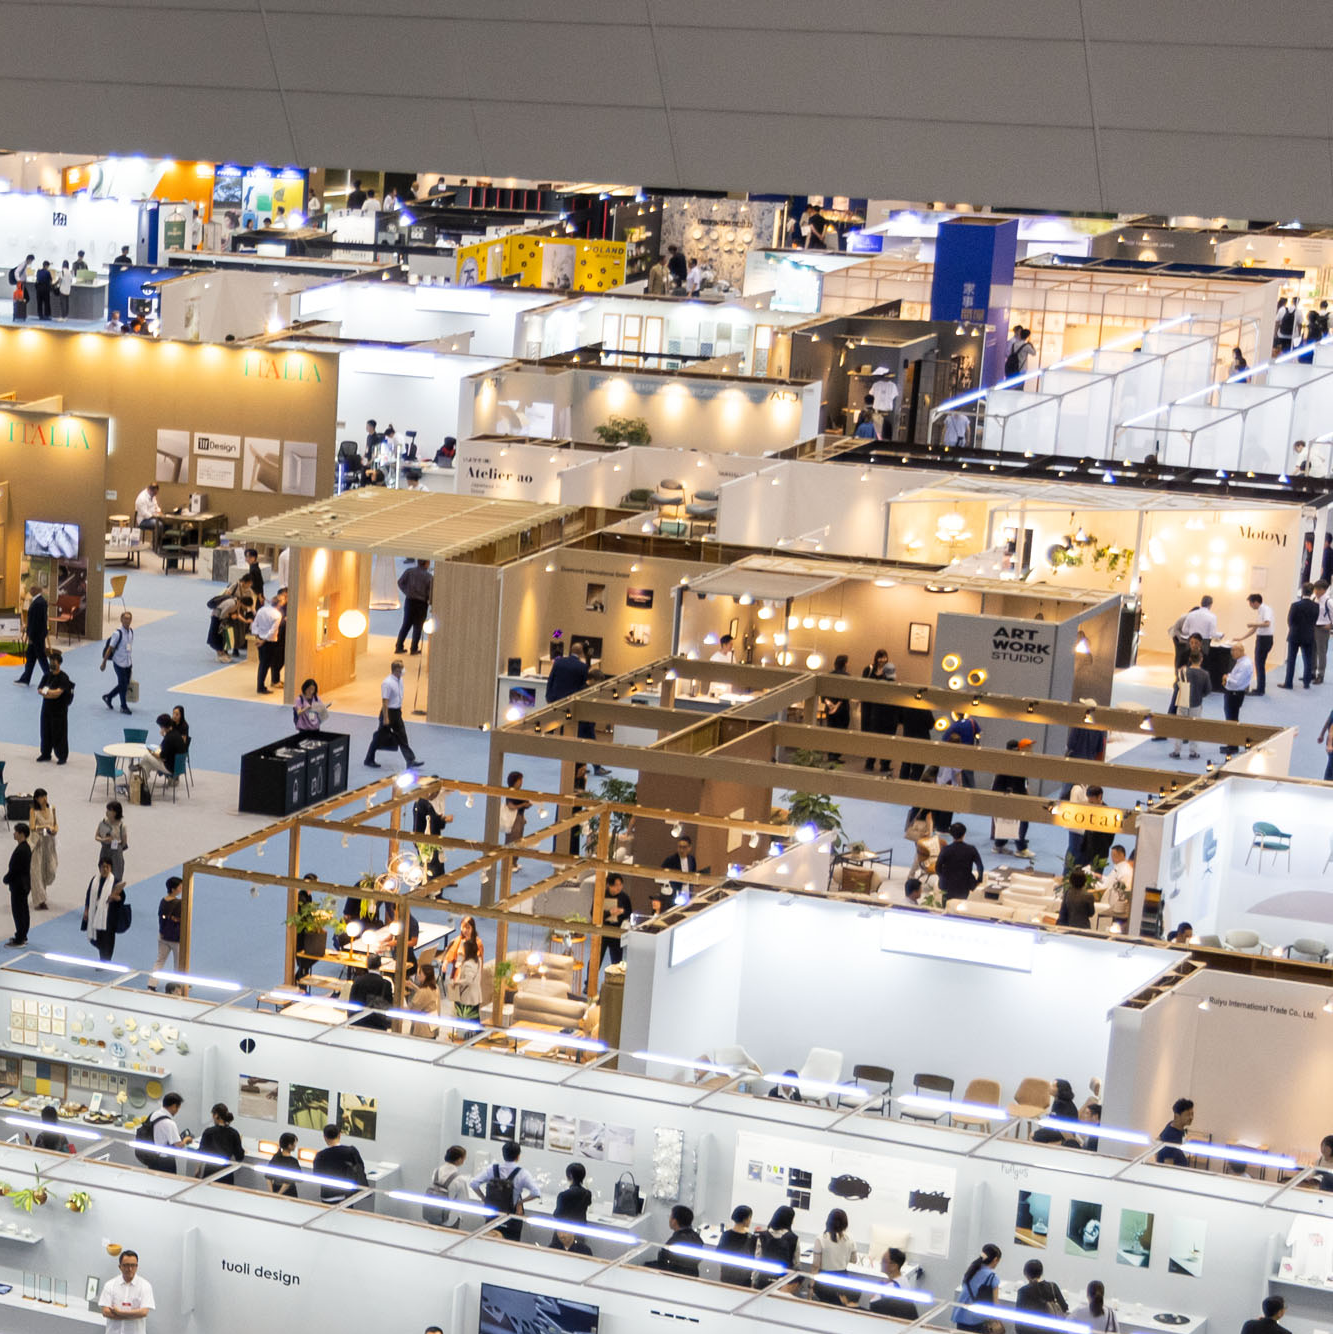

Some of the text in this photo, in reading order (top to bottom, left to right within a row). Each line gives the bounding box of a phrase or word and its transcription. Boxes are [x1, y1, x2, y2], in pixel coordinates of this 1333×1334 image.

[243, 358, 322, 383] ITALIA
[7, 421, 90, 450] ITALIA
[209, 440, 237, 454] Design
[468, 466, 533, 484] Atelier ao
[994, 626, 1038, 641] ART
[993, 639, 1051, 655] WORK
[991, 652, 1044, 665] STUDIO
[1209, 996, 1228, 1007] Ruiyu
[1228, 1000, 1268, 1012] International
[1270, 1005, 1287, 1015] Trade
[221, 1259, 300, 1286] tuoli design
